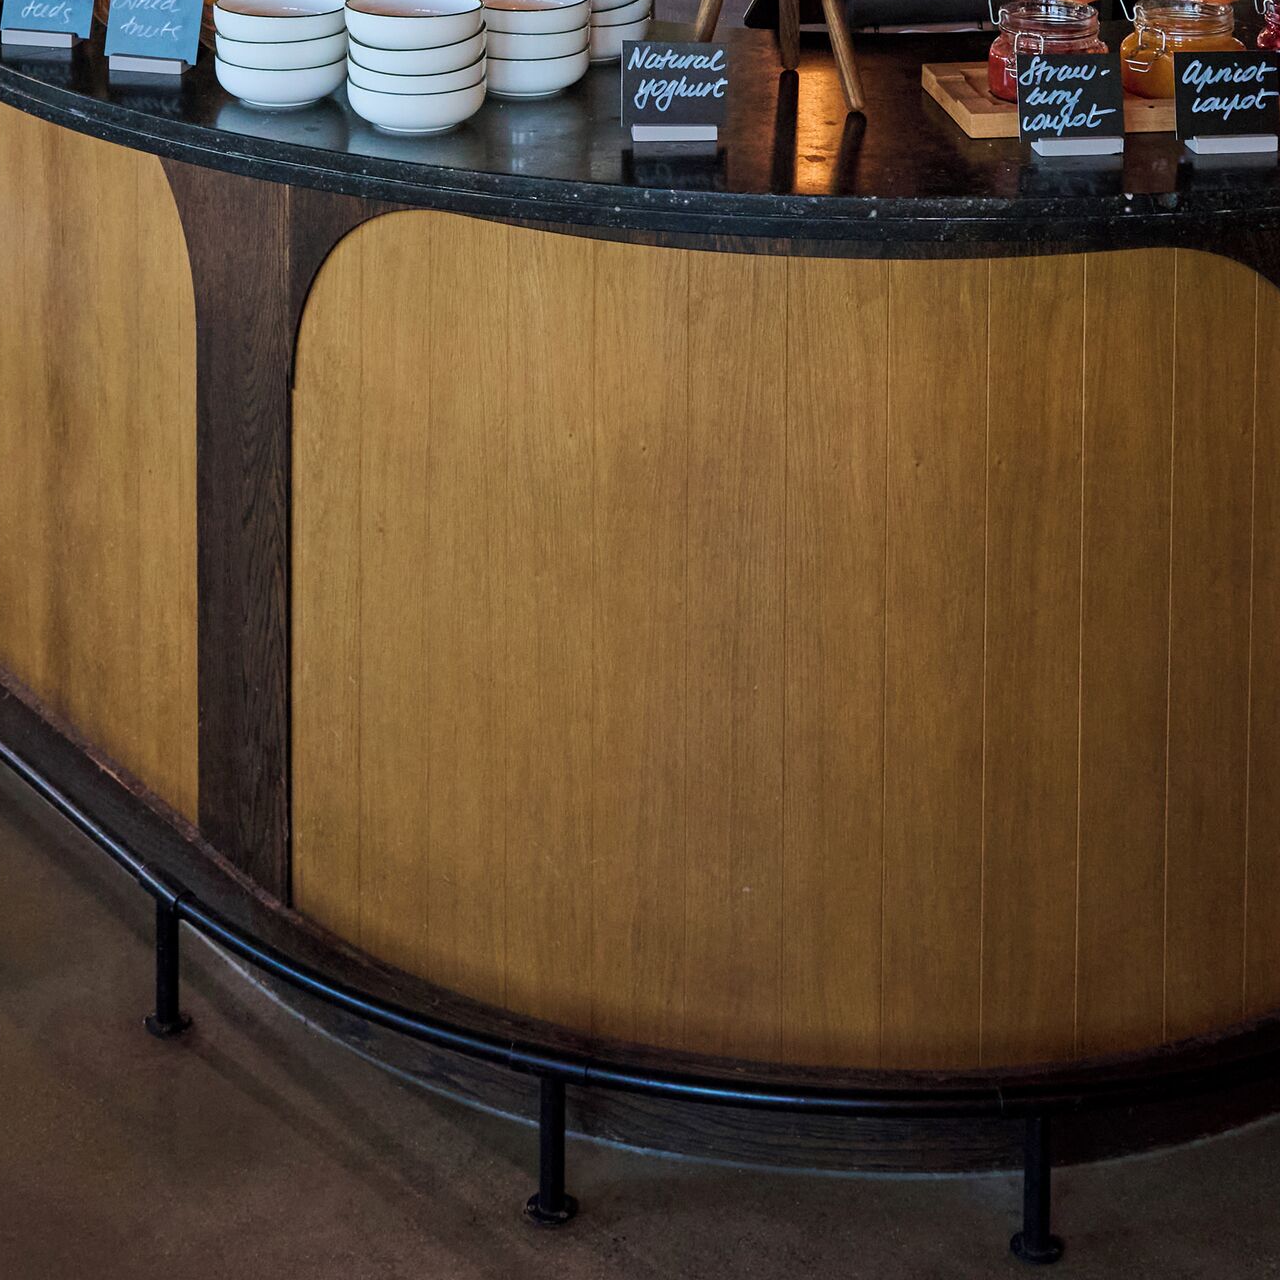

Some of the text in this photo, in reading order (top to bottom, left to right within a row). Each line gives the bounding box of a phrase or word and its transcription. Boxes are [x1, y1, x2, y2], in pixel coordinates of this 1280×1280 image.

[21, 0, 73, 25] seeds
[626, 45, 726, 72] Natural
[633, 75, 729, 112] yoghurt
